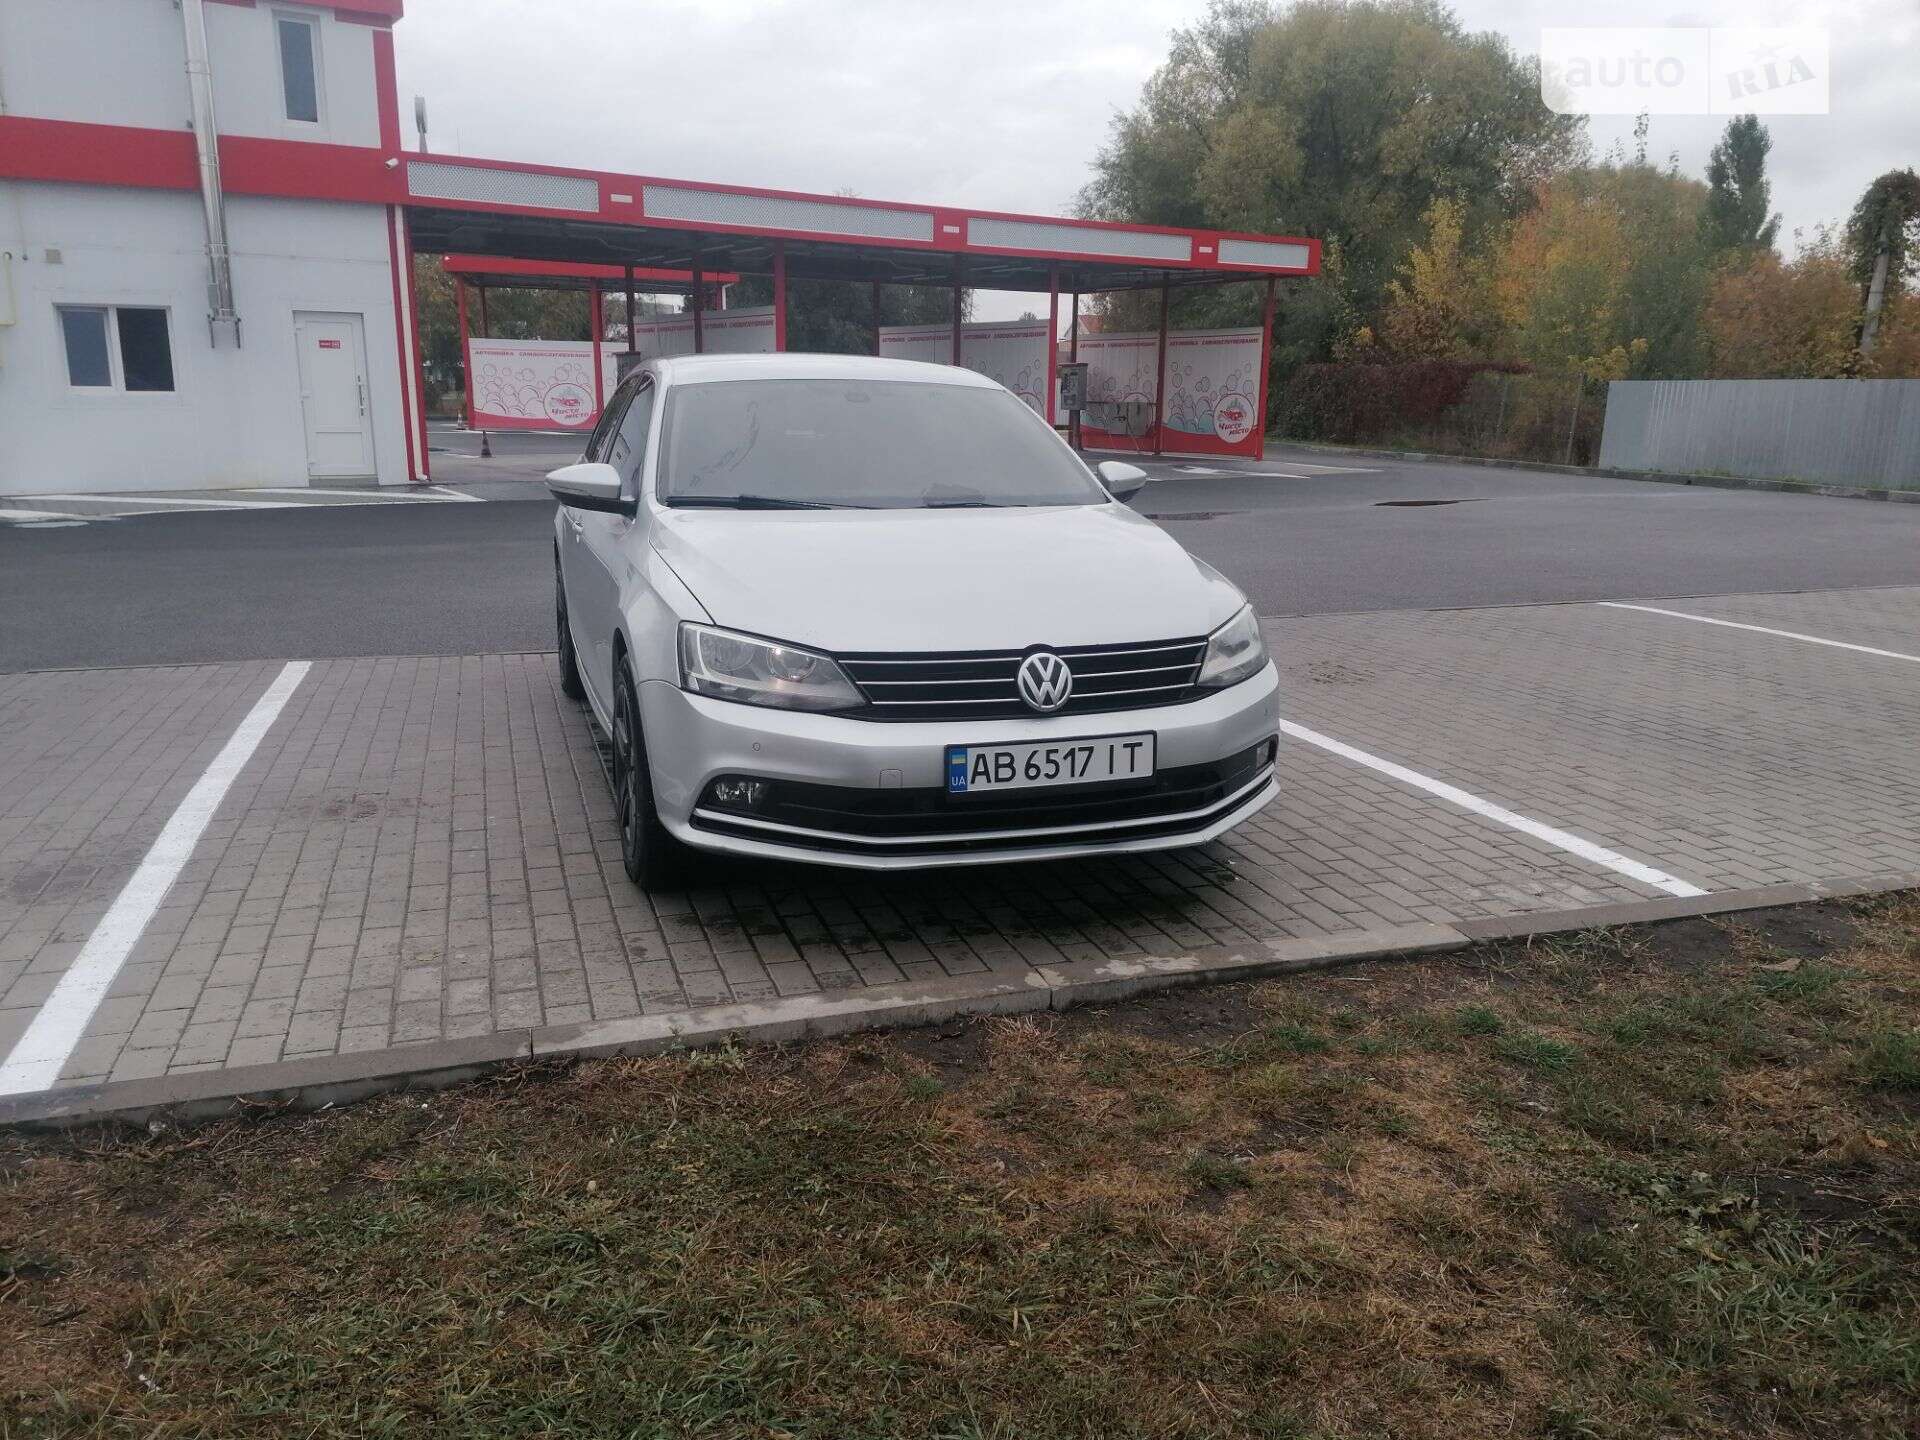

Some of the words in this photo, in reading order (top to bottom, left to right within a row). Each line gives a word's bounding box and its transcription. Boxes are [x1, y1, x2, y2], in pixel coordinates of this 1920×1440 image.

[970, 752, 1016, 784] AB
[1024, 745, 1095, 781] 6517
[1109, 742, 1143, 775] IT
[951, 775, 967, 786] UA
